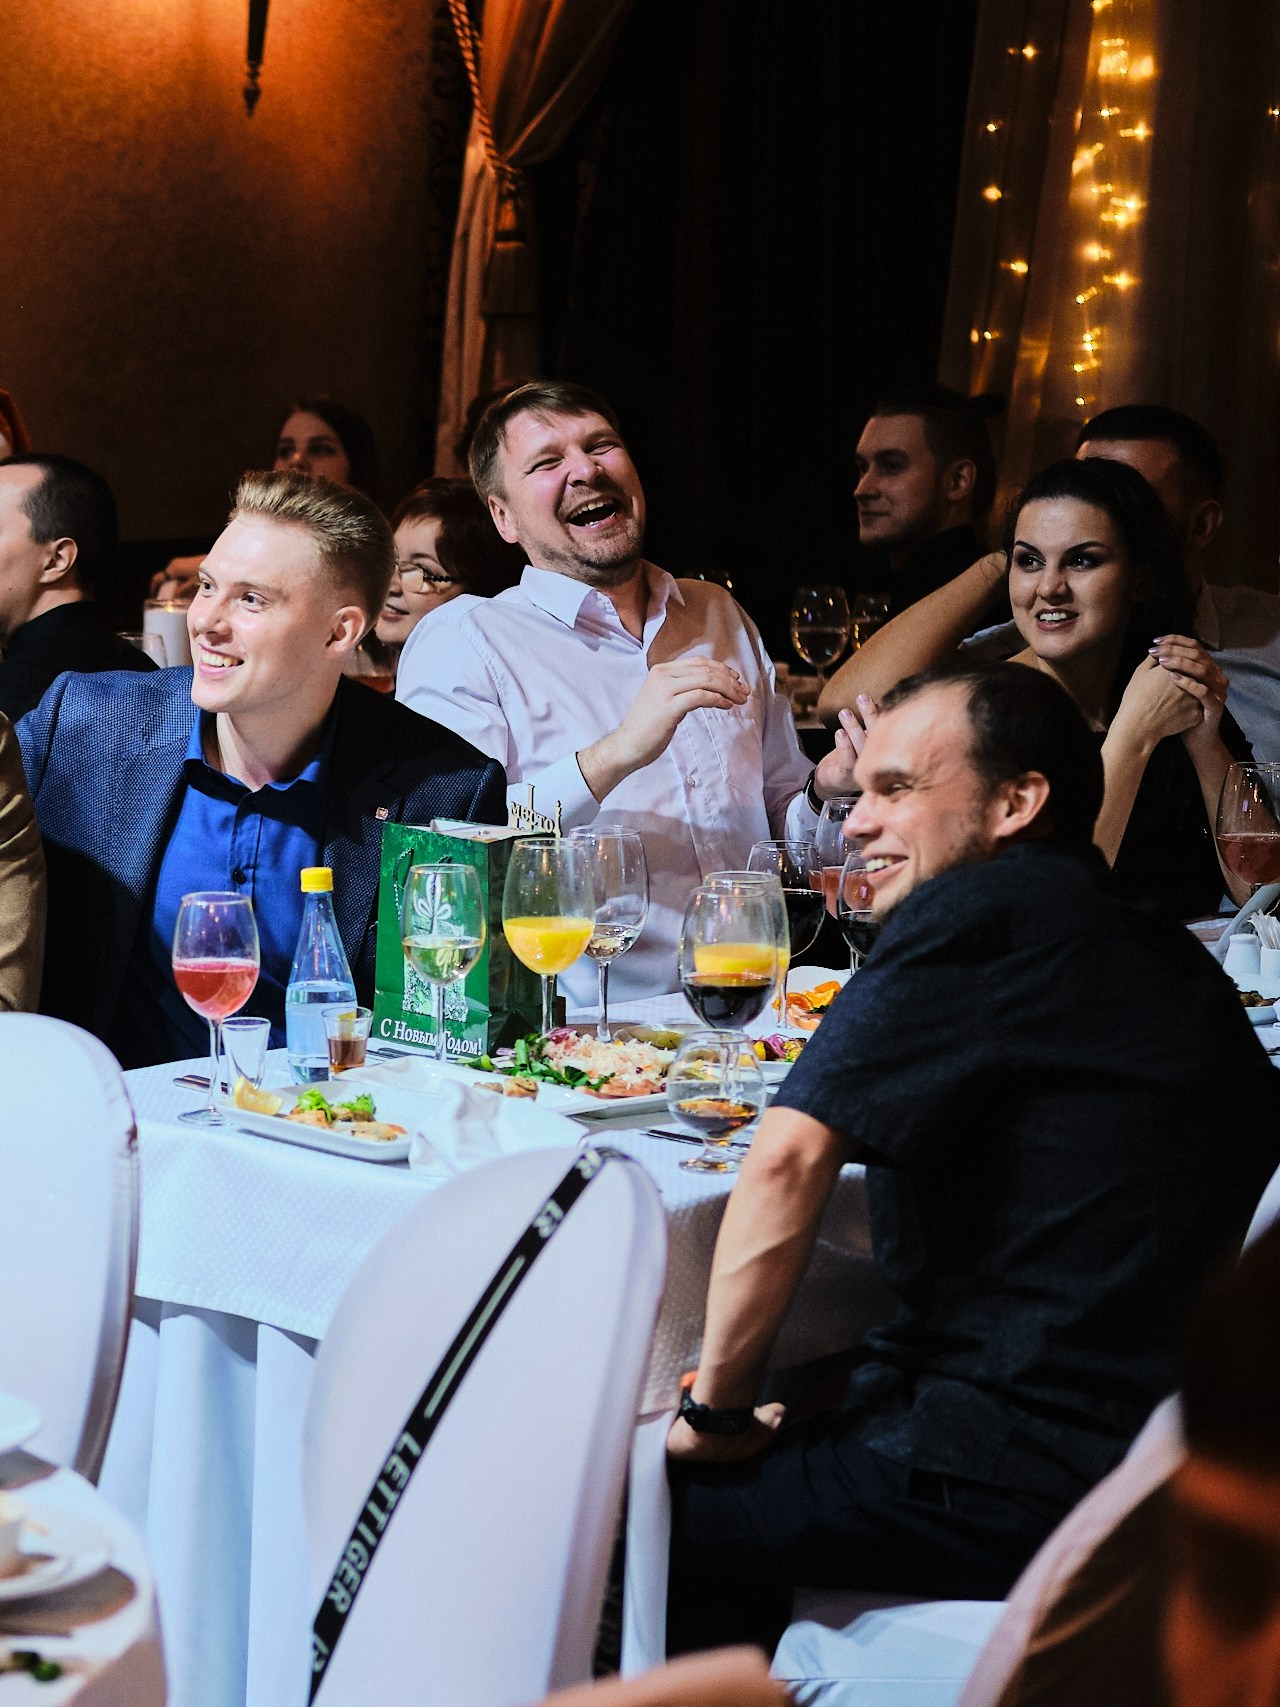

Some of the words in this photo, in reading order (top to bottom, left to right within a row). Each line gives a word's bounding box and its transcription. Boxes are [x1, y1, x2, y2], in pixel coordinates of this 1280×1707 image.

[380, 1018, 392, 1037] С
[443, 1030, 482, 1056] Годом!
[327, 1431, 421, 1614] LETTIGER
